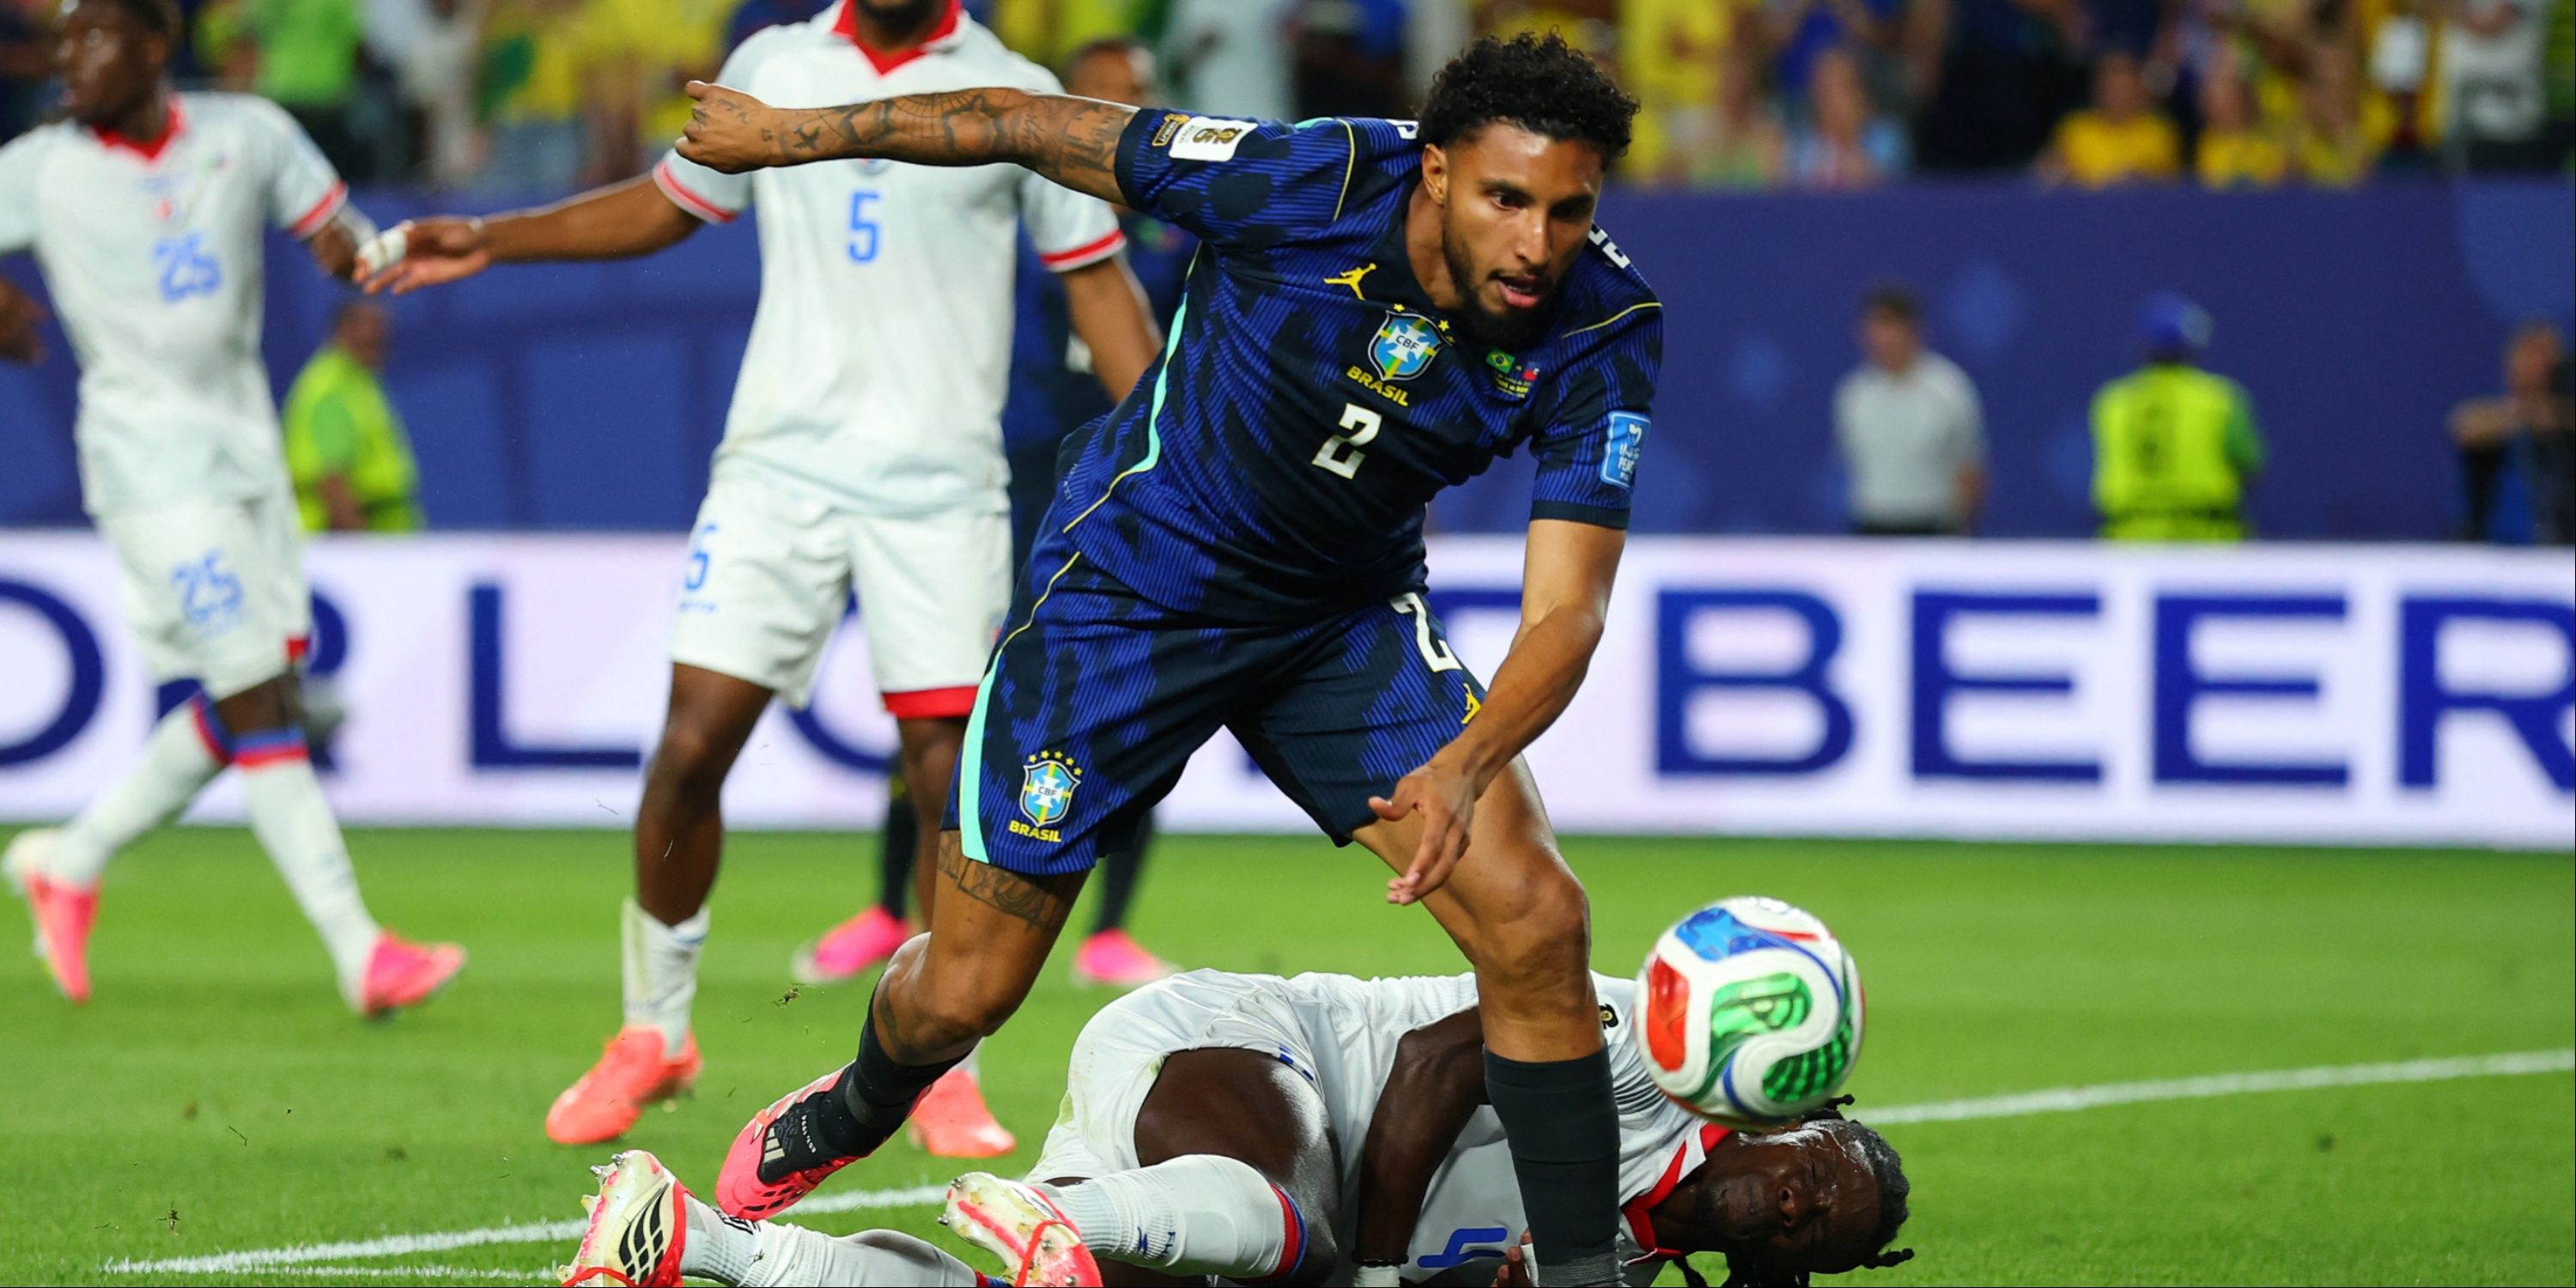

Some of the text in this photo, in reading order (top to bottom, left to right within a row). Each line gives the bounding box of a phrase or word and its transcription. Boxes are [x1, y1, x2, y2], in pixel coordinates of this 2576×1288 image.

[847, 188, 882, 263] 5
[151, 232, 223, 303] 25
[1395, 335, 1420, 350] CBF
[1346, 365, 1408, 407] BRASIL
[1311, 402, 1382, 480] 2
[169, 550, 245, 625] 25
[1388, 592, 1462, 672] 2
[1655, 587, 2575, 792] BEER
[1037, 786, 1058, 797] CBF
[1008, 819, 1062, 842] BRASIL
[1417, 1228, 1509, 1268] 4
